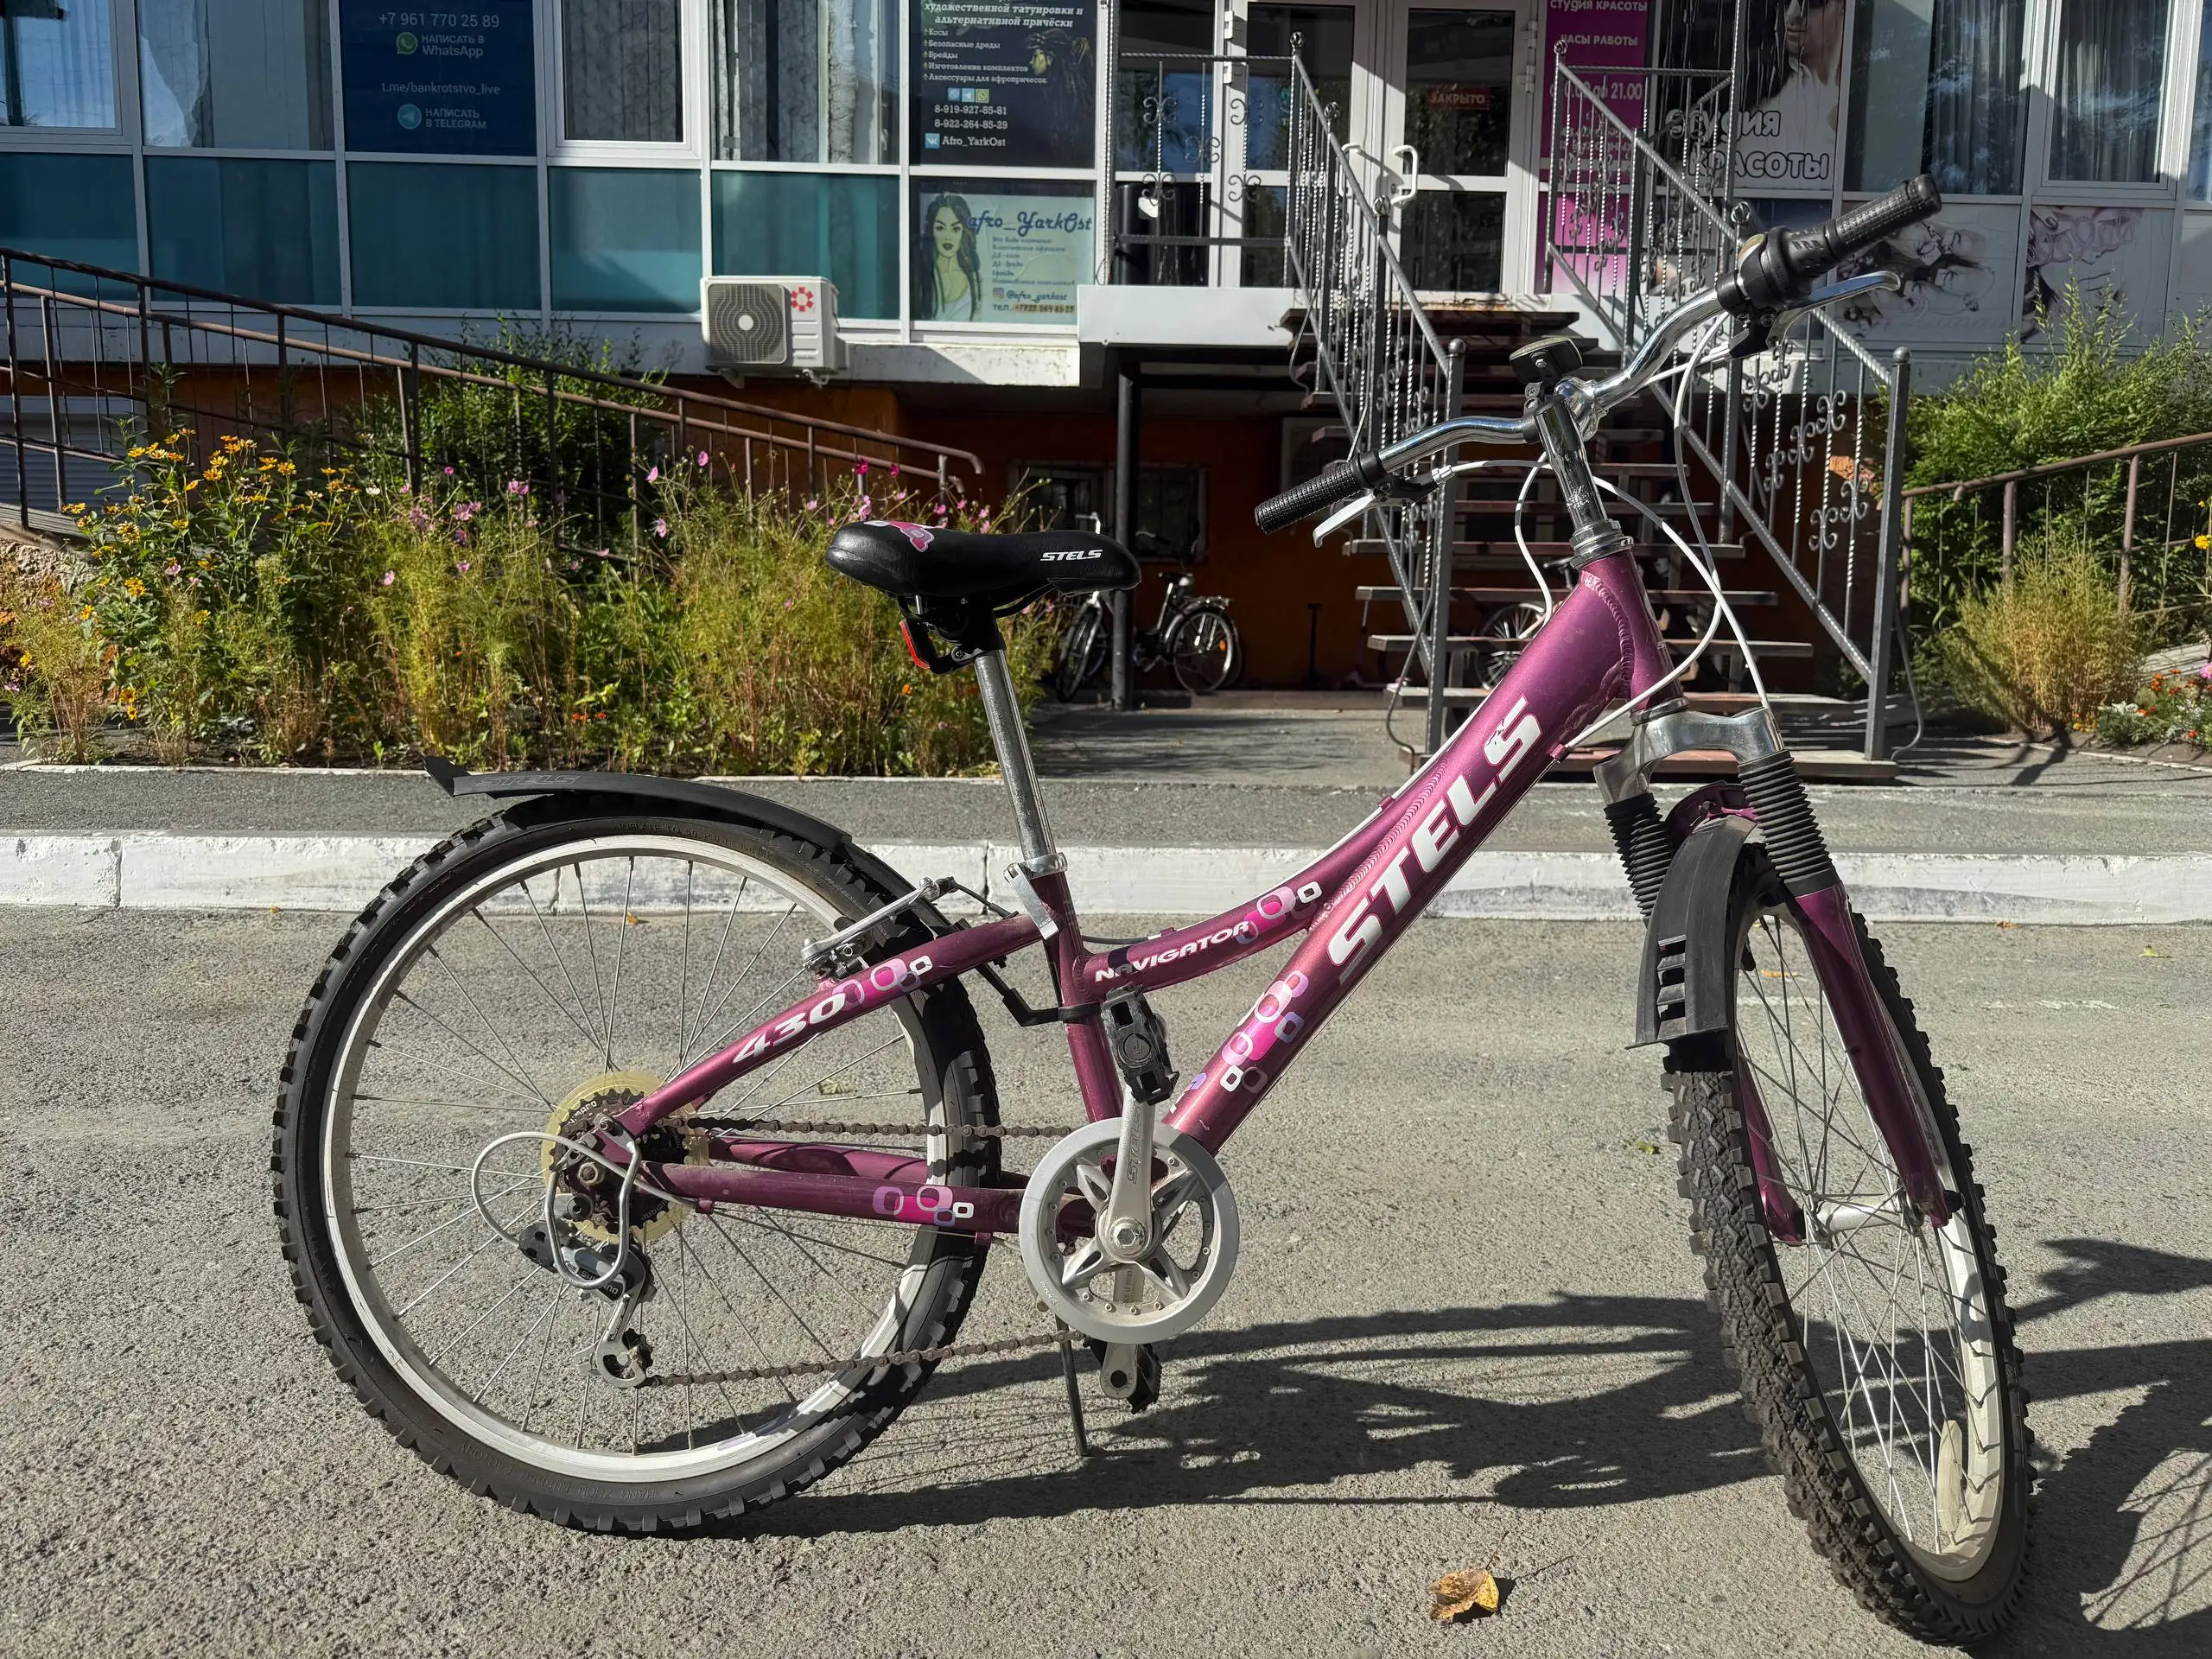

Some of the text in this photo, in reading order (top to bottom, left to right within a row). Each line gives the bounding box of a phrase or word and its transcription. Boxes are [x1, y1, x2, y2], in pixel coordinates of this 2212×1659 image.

[925, 3, 1009, 13] художественной
[1013, 5, 1074, 16] татуировки
[378, 12, 499, 27] +7 961 770 25 89
[935, 16, 1020, 27] альтернативной
[421, 35, 475, 43] НАПИСАТЬ
[1593, 35, 1638, 46] РАБОТЫ
[422, 45, 484, 58] WhatsApp
[381, 82, 500, 94] t.me/bankrotstvo_live
[1611, 82, 1643, 100] 21.00
[1431, 92, 1485, 105] ЗАКРЫТО
[425, 108, 480, 118] НАПИСАТЬ
[934, 105, 1007, 115] 8-919-927-85-81
[435, 119, 486, 129] TELEGRAM
[942, 136, 1006, 147] Afro_YarkOst
[1040, 550, 1103, 562] STELS
[1328, 693, 1541, 987] STELS
[1095, 920, 1250, 982] NAVIGATOR
[733, 992, 847, 1064] 430
